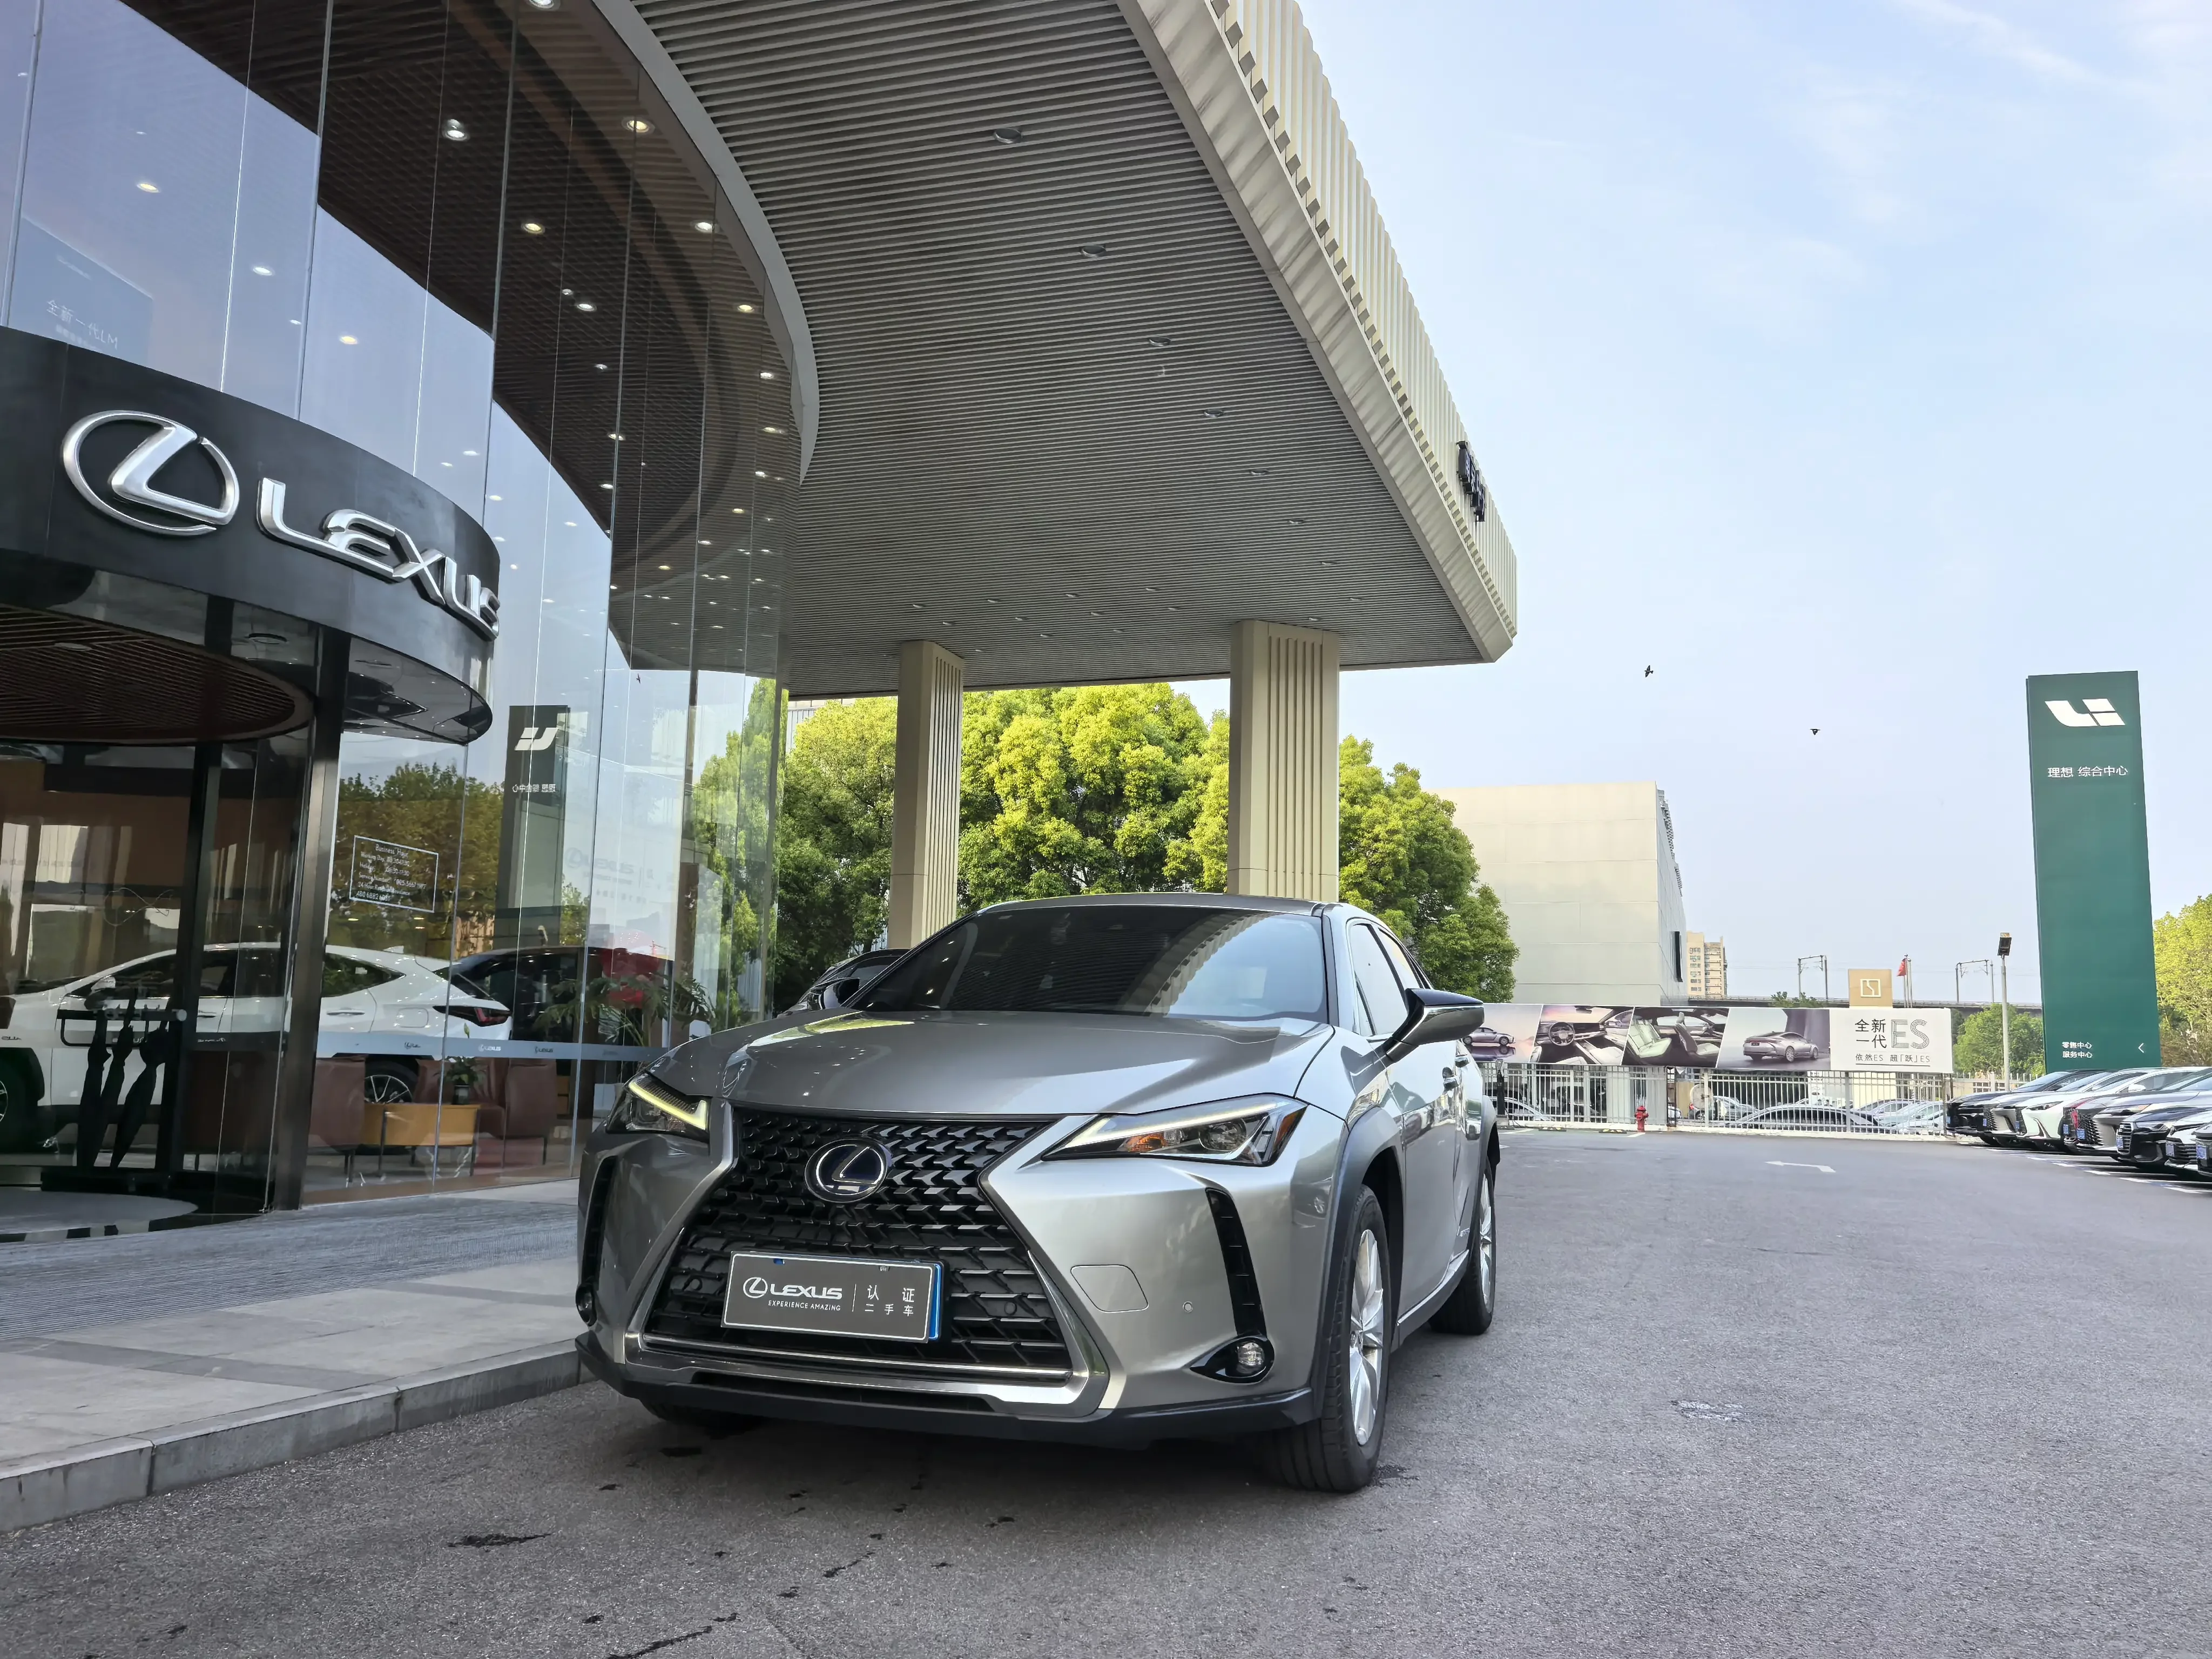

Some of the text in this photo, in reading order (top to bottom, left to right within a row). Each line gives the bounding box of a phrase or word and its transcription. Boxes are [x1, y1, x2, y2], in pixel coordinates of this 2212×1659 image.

[257, 477, 500, 640] LEXUS
[2047, 765, 2128, 778] 理想 综合中心
[1855, 1019, 1886, 1033] 全新
[1856, 1034, 1887, 1048] 一代
[1891, 1020, 1930, 1049] ES
[1856, 1054, 1883, 1062] 依然ES
[770, 1284, 842, 1300] LEXUS
[768, 1300, 841, 1311] EXPERIENCE AMAZING
[865, 1304, 914, 1317] 二手车
